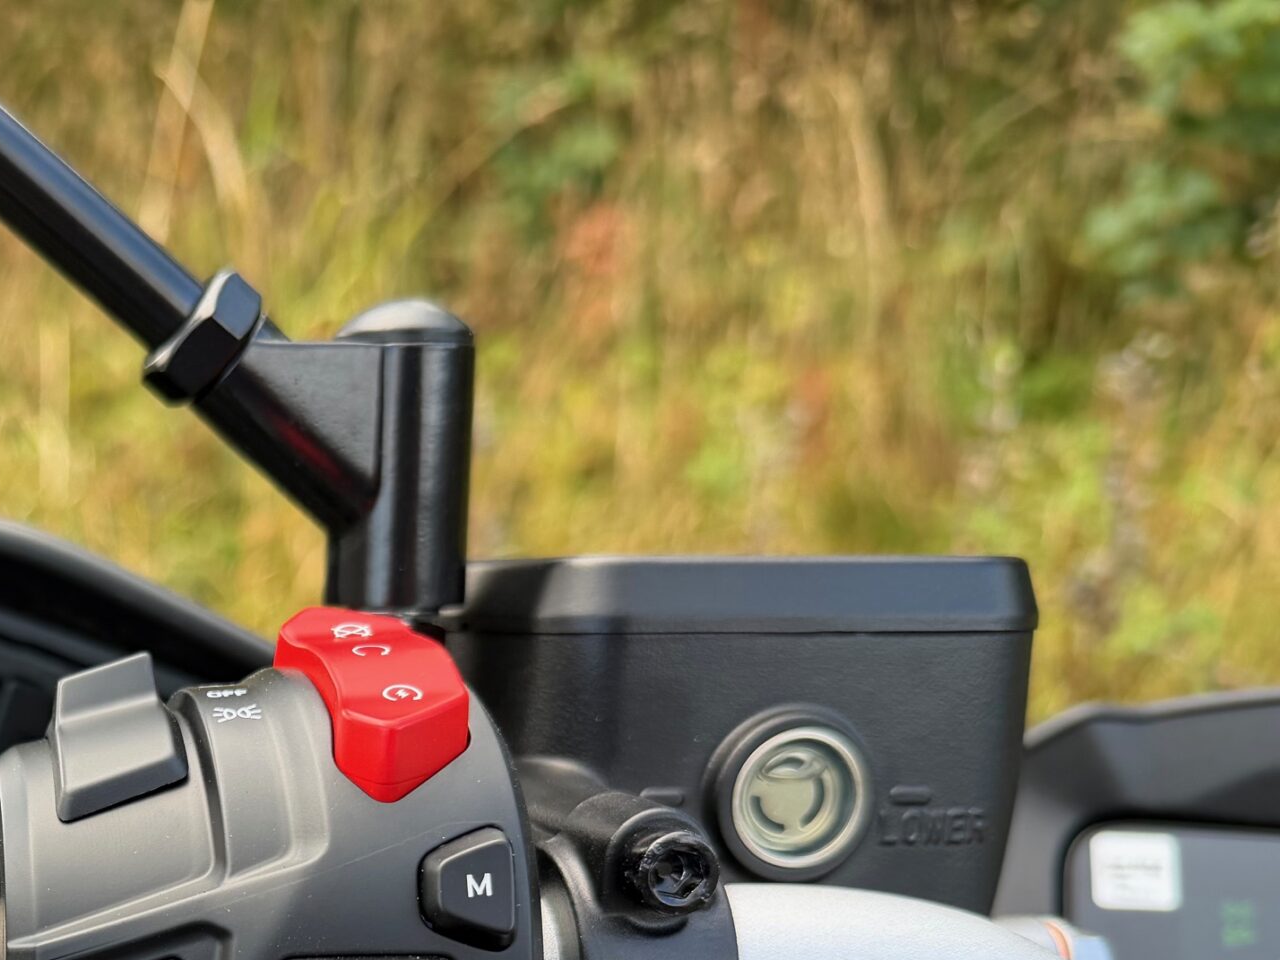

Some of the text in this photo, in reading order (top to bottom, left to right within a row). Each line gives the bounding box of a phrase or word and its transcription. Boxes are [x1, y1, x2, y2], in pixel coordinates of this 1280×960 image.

[206, 688, 247, 698] OFF
[877, 807, 987, 848] LOWER
[466, 872, 493, 898] M
